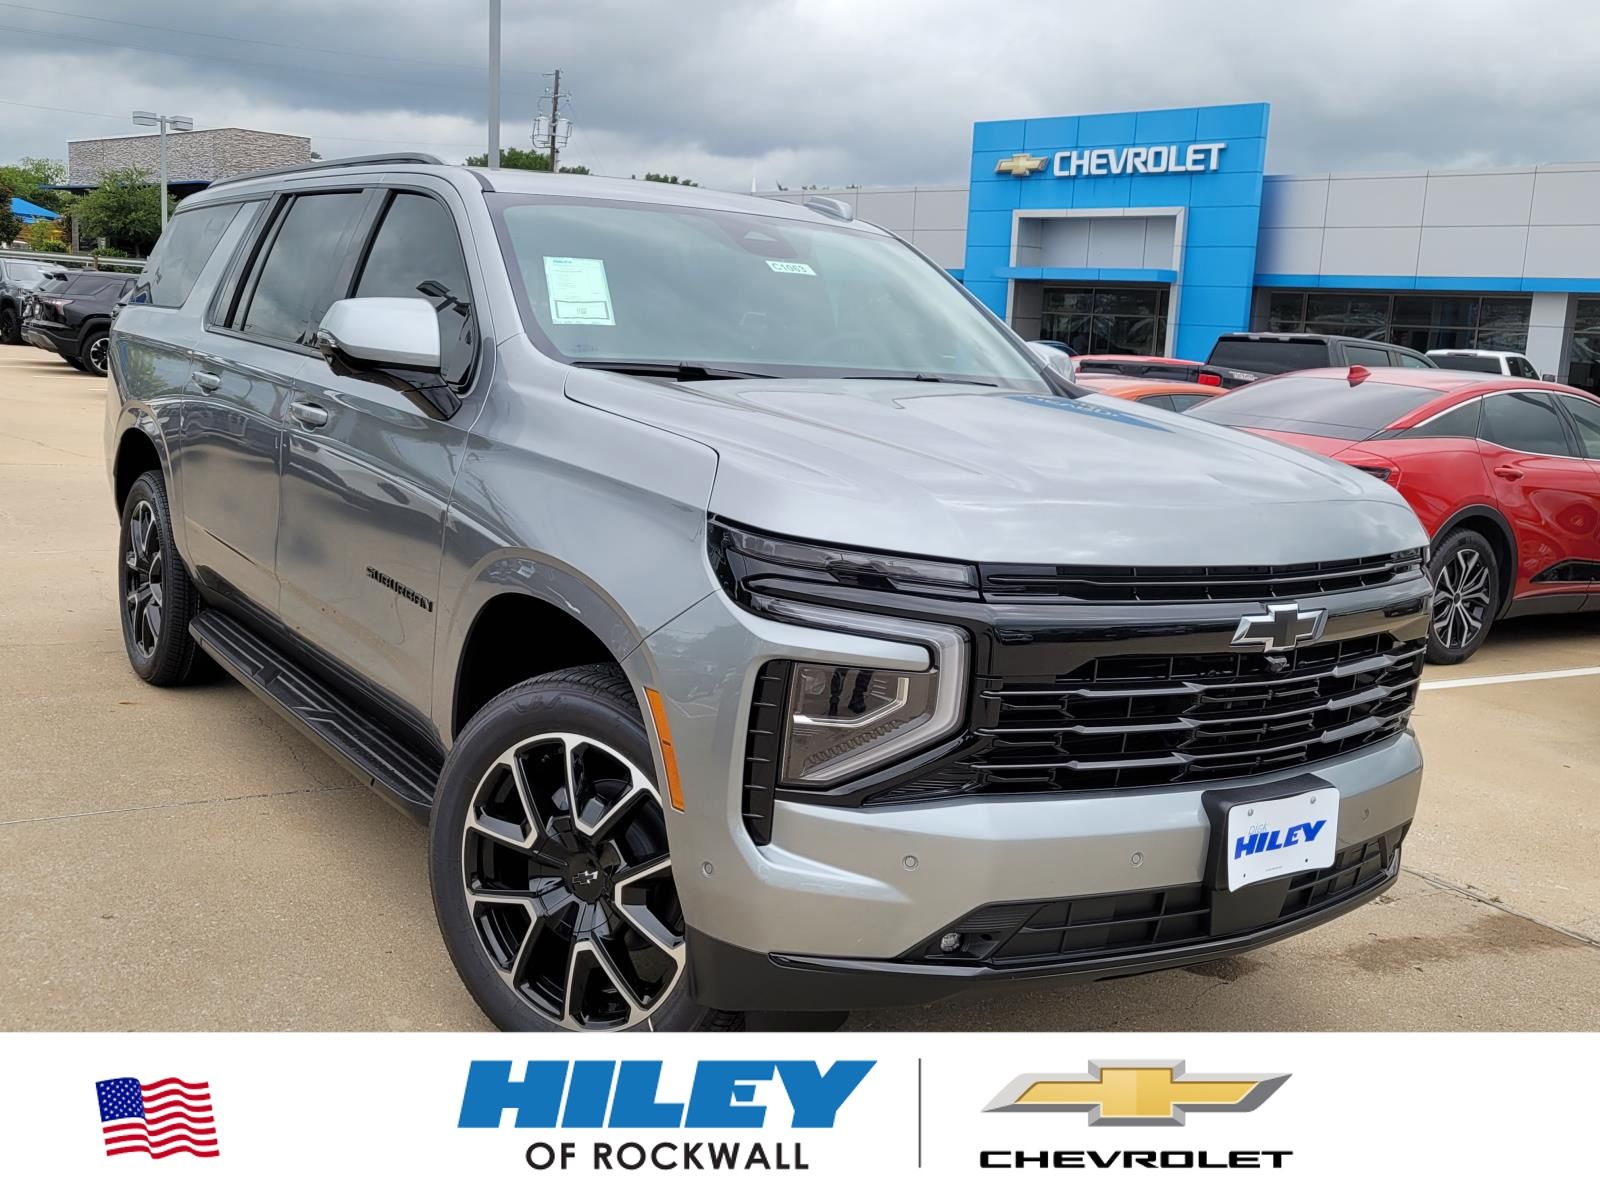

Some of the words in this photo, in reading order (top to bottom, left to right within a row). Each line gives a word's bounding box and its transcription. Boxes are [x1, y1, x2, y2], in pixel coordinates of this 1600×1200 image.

[1053, 142, 1226, 177] CHEVROLET
[366, 566, 433, 613] SUBURBAN
[1234, 820, 1327, 860] HILEY
